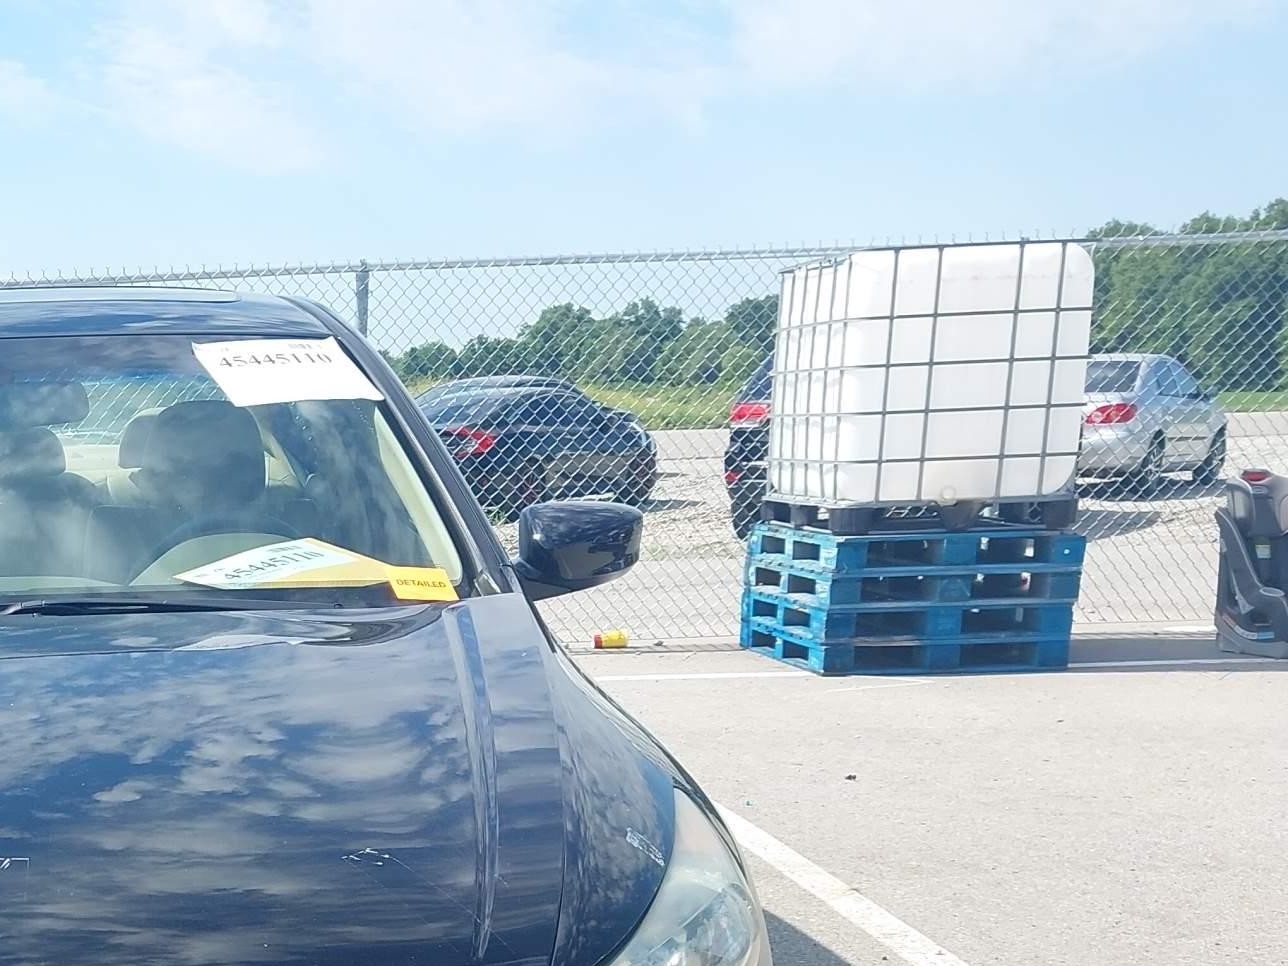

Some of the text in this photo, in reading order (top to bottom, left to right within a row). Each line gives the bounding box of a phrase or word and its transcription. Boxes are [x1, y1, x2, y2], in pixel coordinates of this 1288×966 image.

[219, 353, 332, 367] 45445110
[224, 551, 324, 579] 45445110
[396, 579, 447, 588] DETAILED
